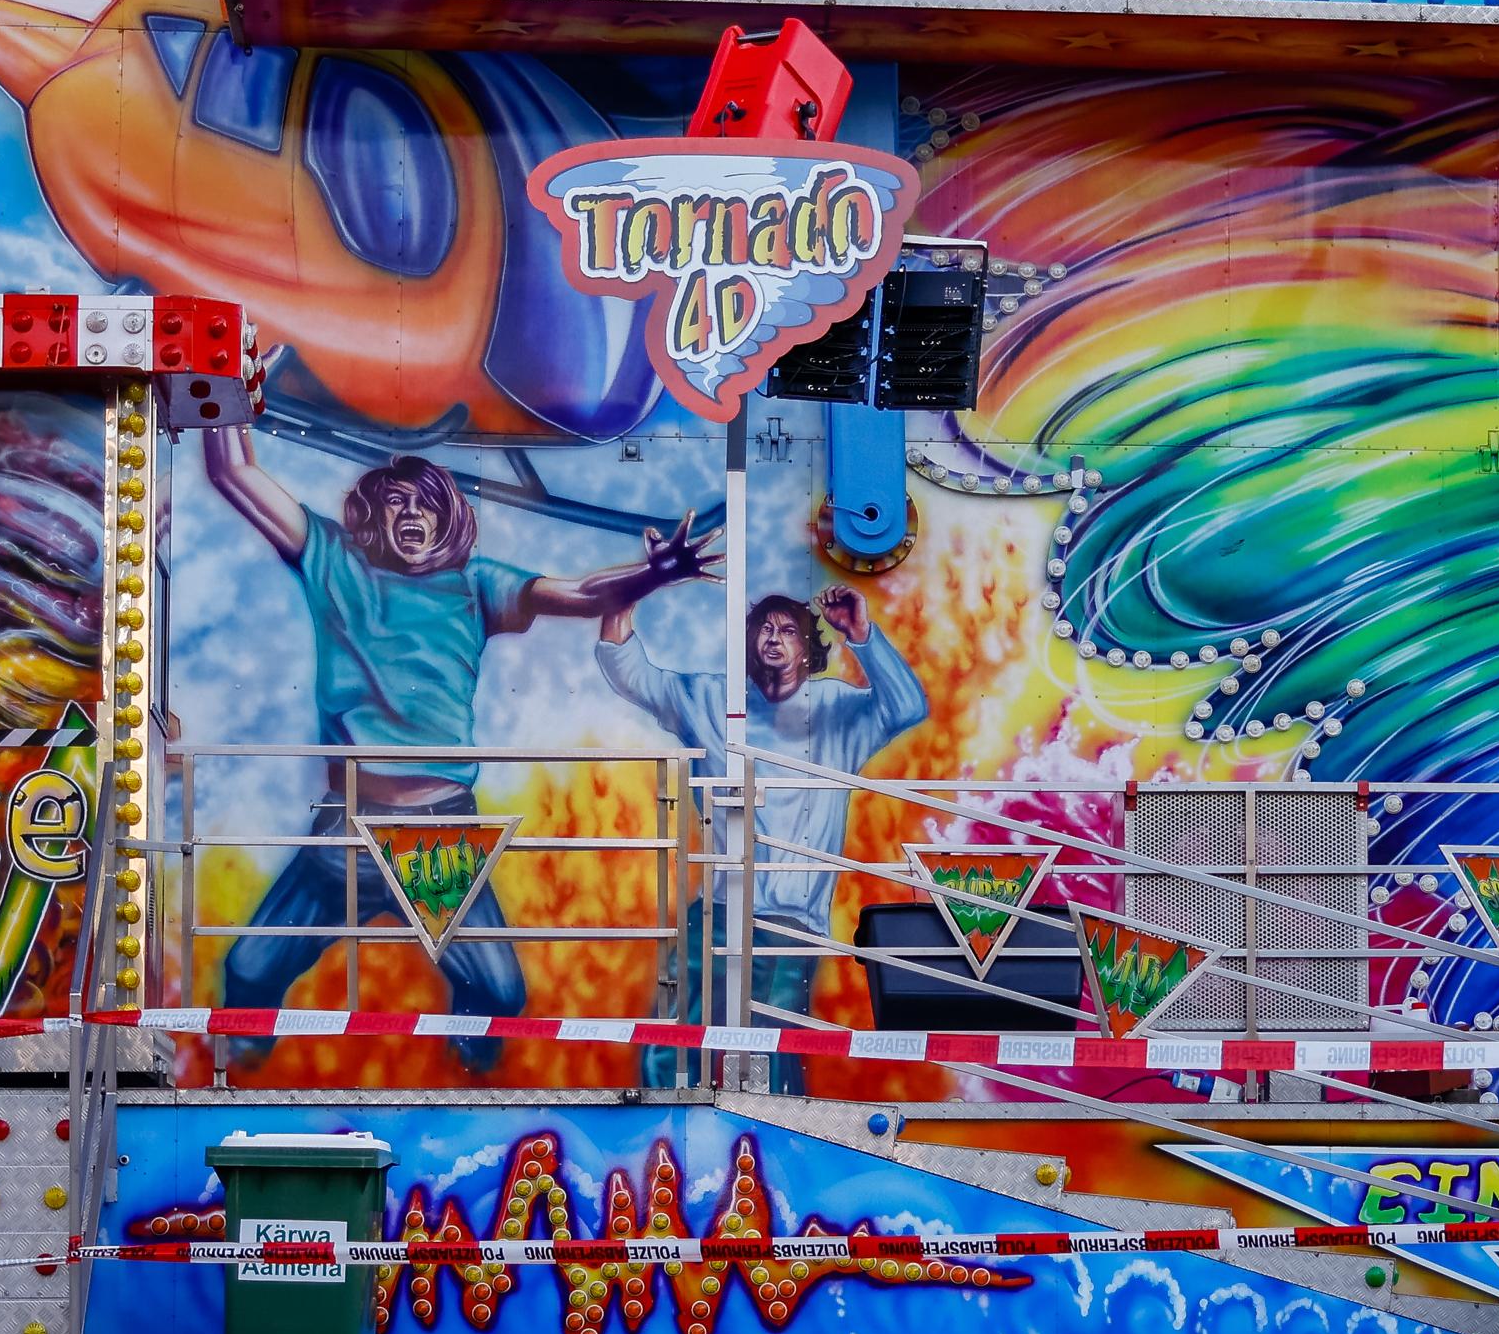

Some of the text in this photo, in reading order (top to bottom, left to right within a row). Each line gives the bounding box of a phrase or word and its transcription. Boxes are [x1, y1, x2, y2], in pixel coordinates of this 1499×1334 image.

[569, 167, 875, 275] Tornado
[672, 268, 757, 354] 4D
[256, 1224, 331, 1244] Kärwa
[351, 1245, 505, 1263] POLIZEIABSPERRUNG
[525, 1244, 680, 1262] POLIZEIABSPERRUNG
[702, 1241, 857, 1259] POLIZEIABSPERRUNG
[878, 1239, 1036, 1257] POLIZEIABSPERRUNG
[1056, 1235, 1216, 1255] POLIZEIABSPERRUNG
[1237, 1231, 1396, 1249] POLIZEIABSPERRUNG
